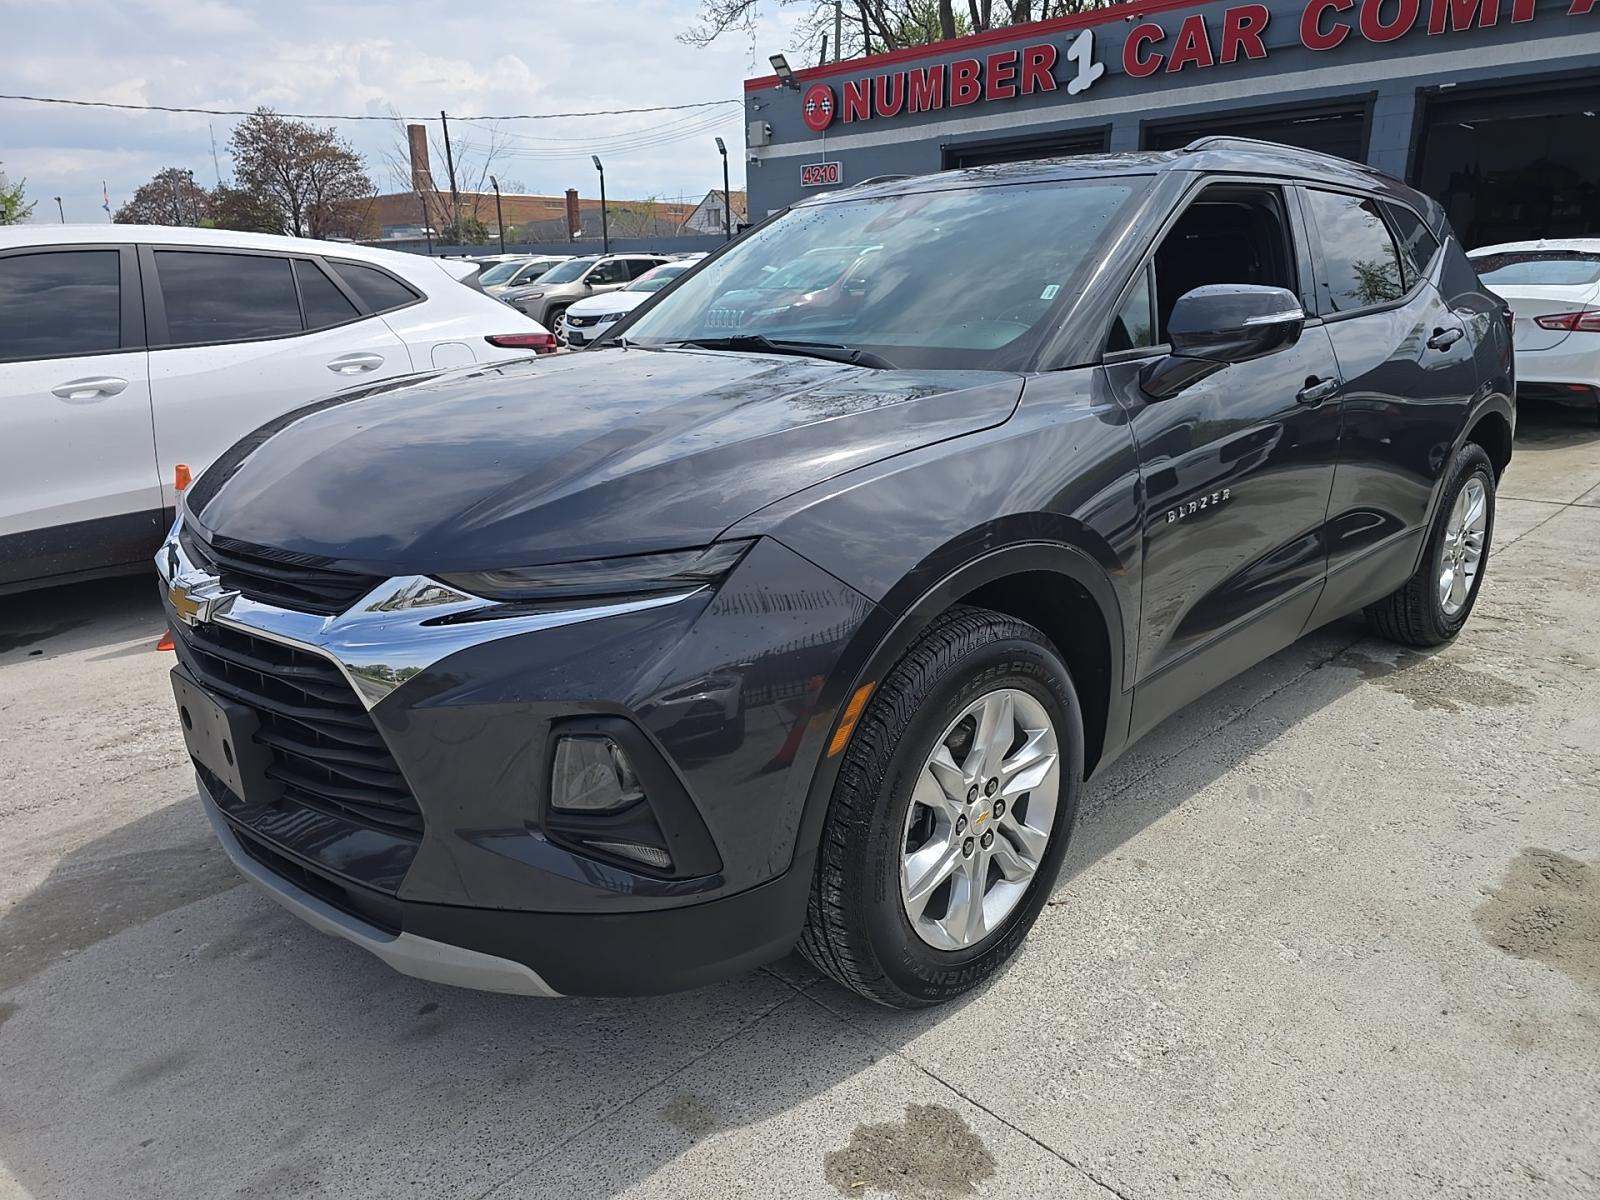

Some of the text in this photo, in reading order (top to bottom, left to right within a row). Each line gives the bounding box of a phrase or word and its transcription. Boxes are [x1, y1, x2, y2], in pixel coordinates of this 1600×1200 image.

[842, 44, 1058, 124] NUMBER
[1067, 28, 1105, 95] 1
[1123, 4, 1268, 78] CAR
[803, 164, 838, 184] 4210
[1166, 488, 1232, 523] BLAZER
